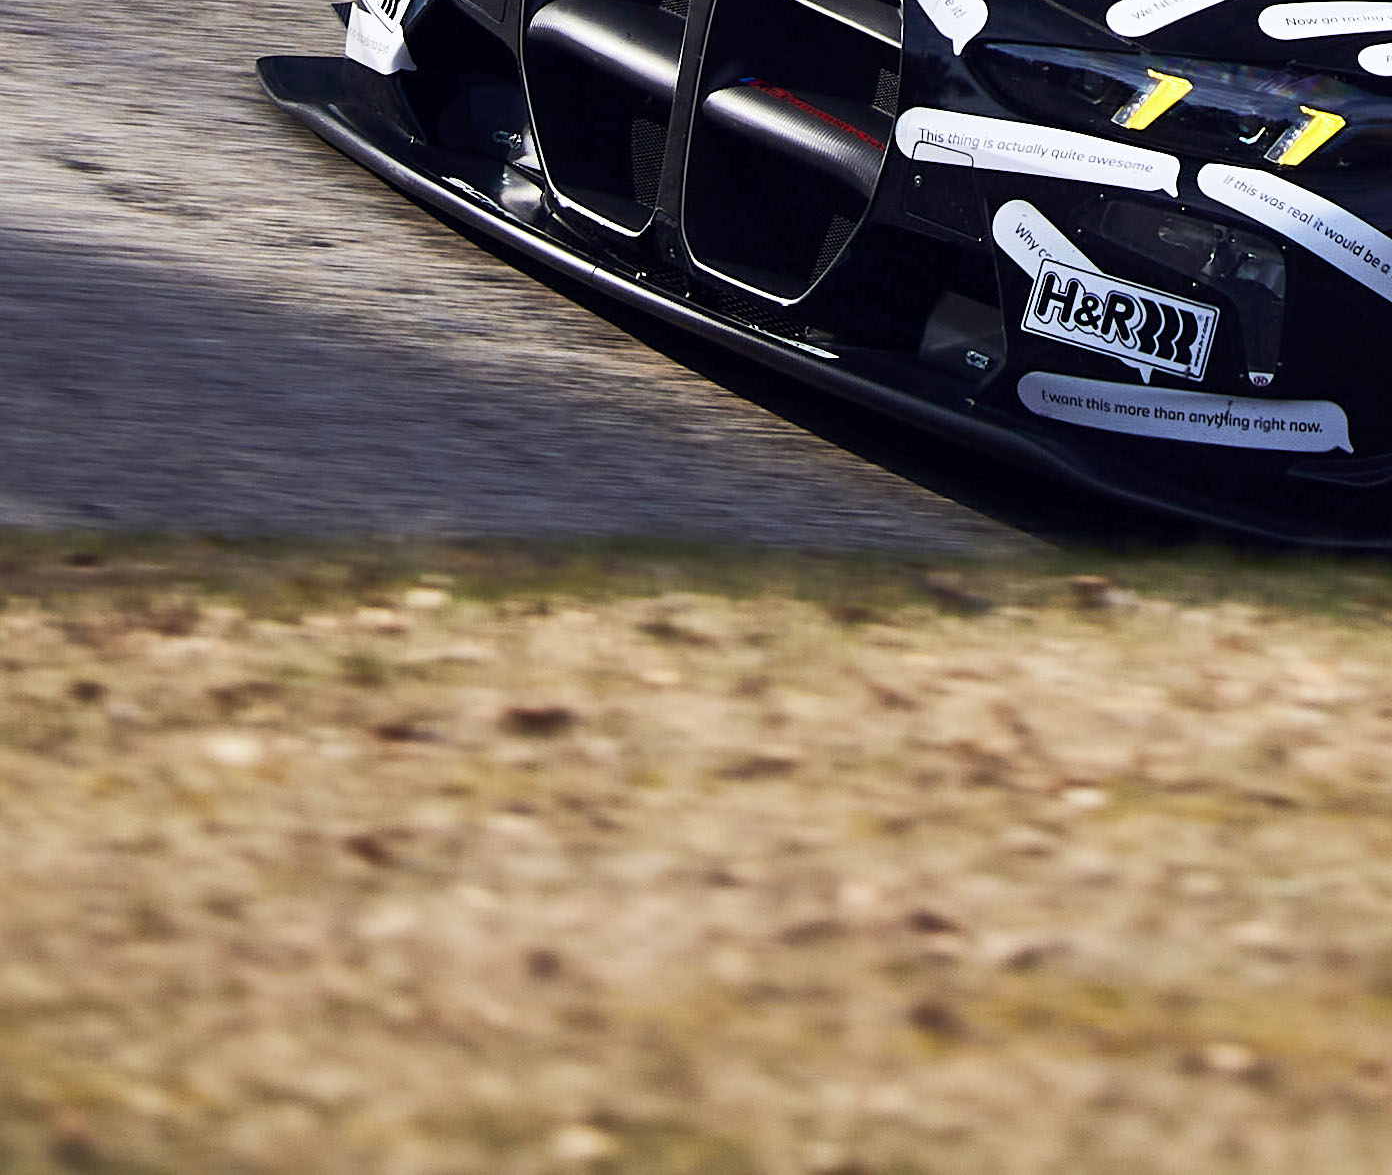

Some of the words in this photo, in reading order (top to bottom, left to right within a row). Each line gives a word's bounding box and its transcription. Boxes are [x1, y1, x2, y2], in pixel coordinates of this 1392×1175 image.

[1285, 15, 1317, 27] Now
[918, 127, 945, 144] This
[947, 132, 980, 150] thing
[996, 139, 1049, 158] actually
[1050, 146, 1086, 164] quite
[1087, 154, 1155, 174] awesome
[1014, 221, 1041, 254] Why
[1233, 177, 1259, 196] this
[1259, 189, 1287, 211] was
[1286, 200, 1314, 225] real
[1323, 222, 1363, 258] would
[1361, 246, 1382, 268] be
[1048, 390, 1086, 410] want
[1085, 395, 1112, 414] this
[1113, 402, 1151, 419] more
[1153, 404, 1186, 424] than
[1187, 409, 1251, 432] anything
[1252, 414, 1286, 435] right
[1288, 418, 1324, 435] now.
